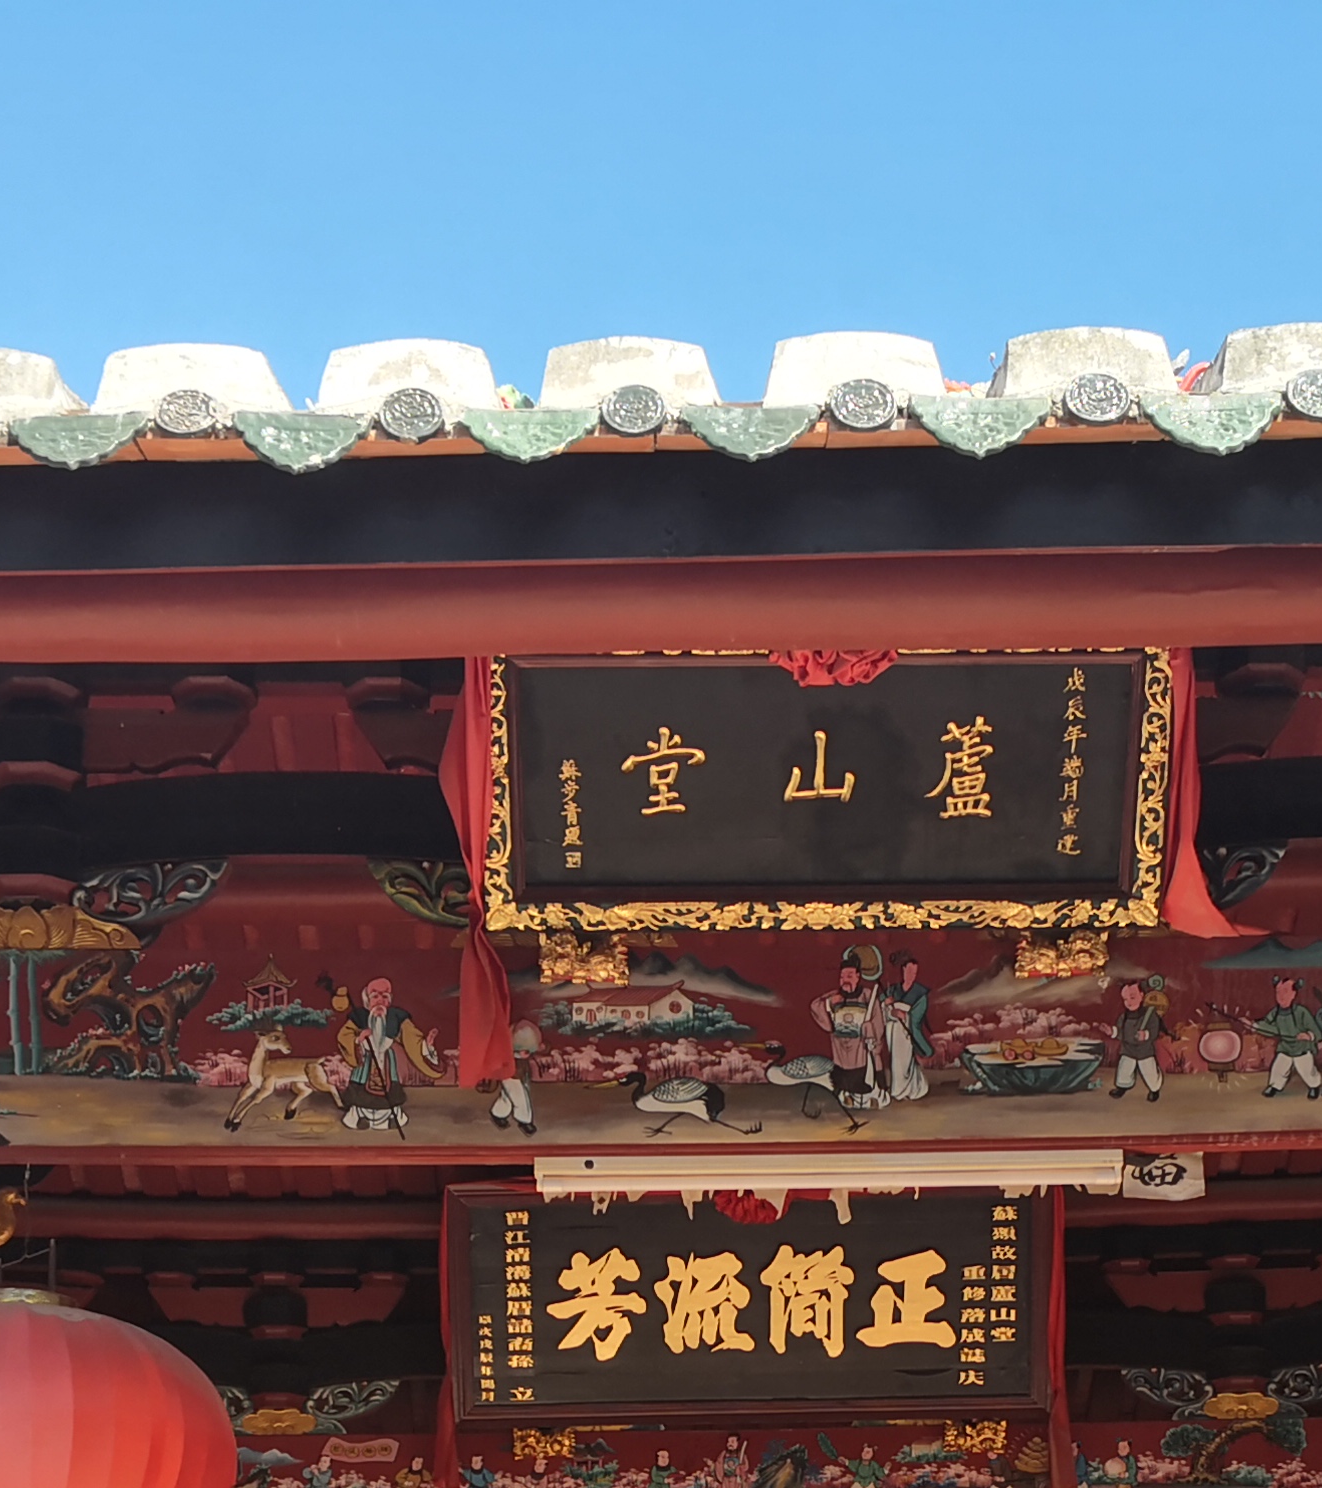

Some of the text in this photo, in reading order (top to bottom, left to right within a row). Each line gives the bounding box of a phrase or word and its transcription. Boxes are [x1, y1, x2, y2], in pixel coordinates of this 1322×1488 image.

[620, 716, 995, 820] 蘆山堂
[545, 1244, 958, 1362] 正簡流芳
